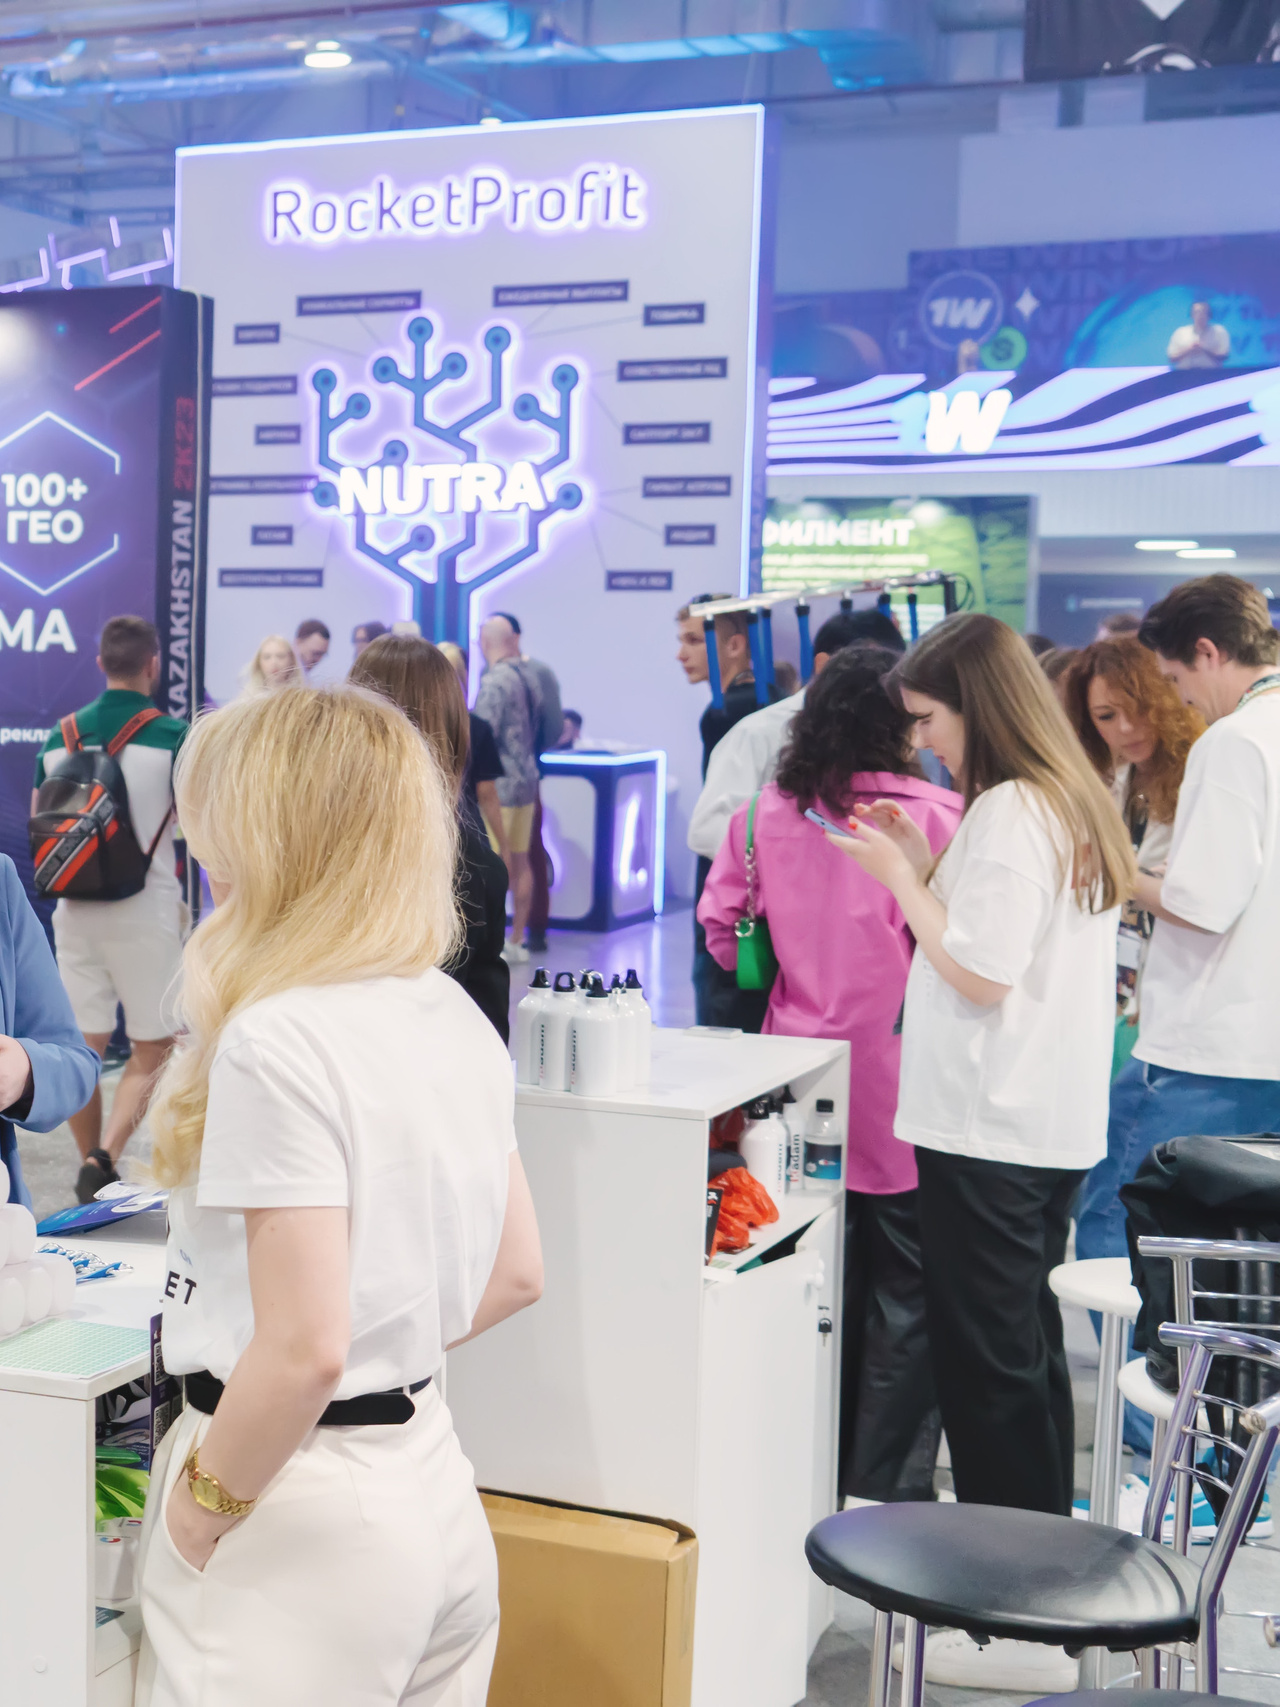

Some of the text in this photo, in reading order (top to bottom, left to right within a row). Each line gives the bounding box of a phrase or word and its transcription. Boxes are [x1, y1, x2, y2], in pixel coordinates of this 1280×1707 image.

[271, 168, 639, 238] RocketProfit
[1, 473, 88, 507] 100+
[338, 461, 547, 515] NUTRA
[7, 510, 83, 544] ГЕО
[167, 500, 193, 719] KAZAKHSTAN
